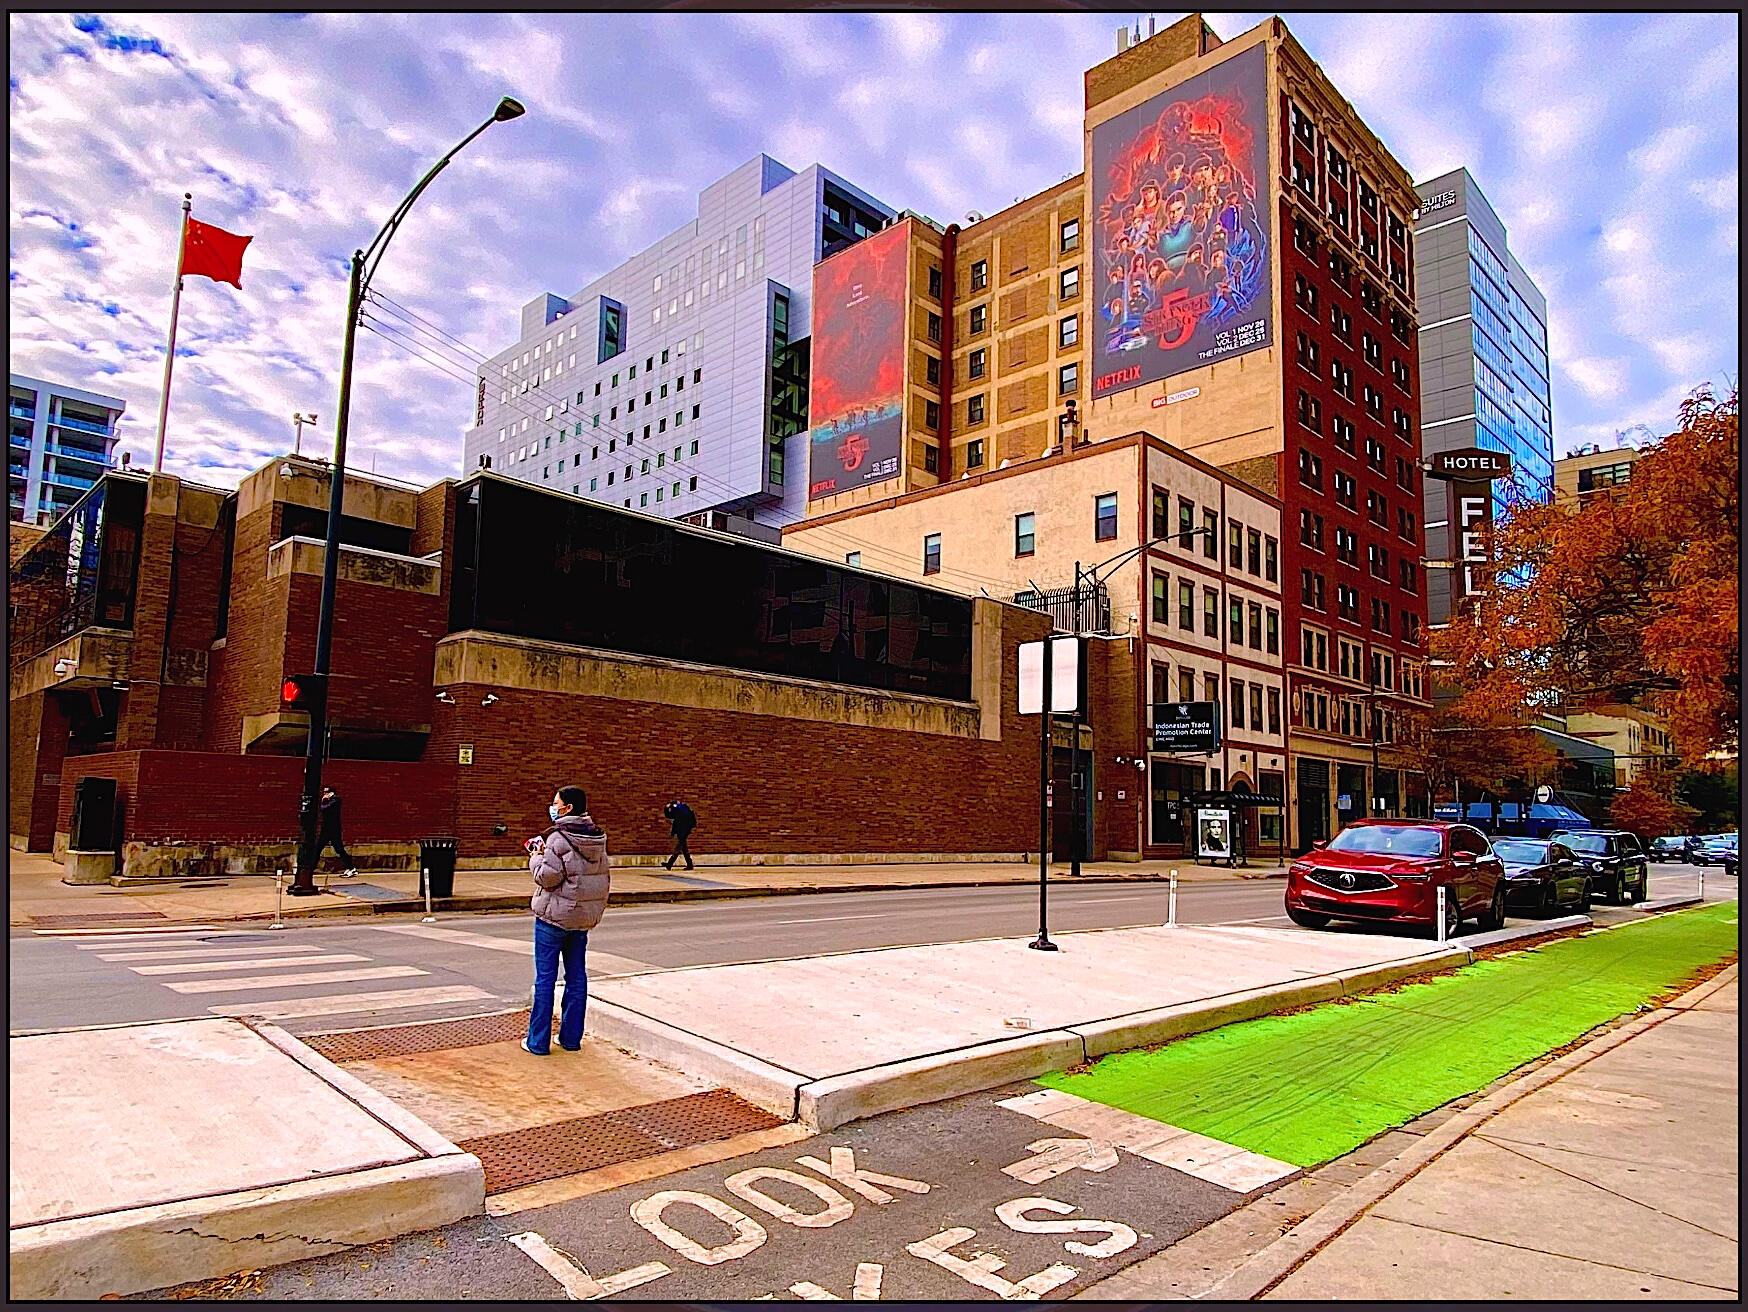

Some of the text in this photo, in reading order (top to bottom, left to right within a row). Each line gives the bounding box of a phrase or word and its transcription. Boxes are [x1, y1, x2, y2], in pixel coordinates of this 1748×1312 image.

[1421, 189, 1455, 208] SUITES
[1215, 331, 1230, 341] VOL
[1238, 322, 1255, 334] NOV
[1216, 338, 1232, 347] VOL
[1239, 330, 1255, 341] DEC
[1198, 333, 1266, 360] THE FINALE DEC 31
[1096, 365, 1141, 390] NETFLIX
[1443, 456, 1501, 471] HOTEL
[1155, 721, 1210, 730] Indonesian Trade
[503, 1146, 931, 1299] LOOK
